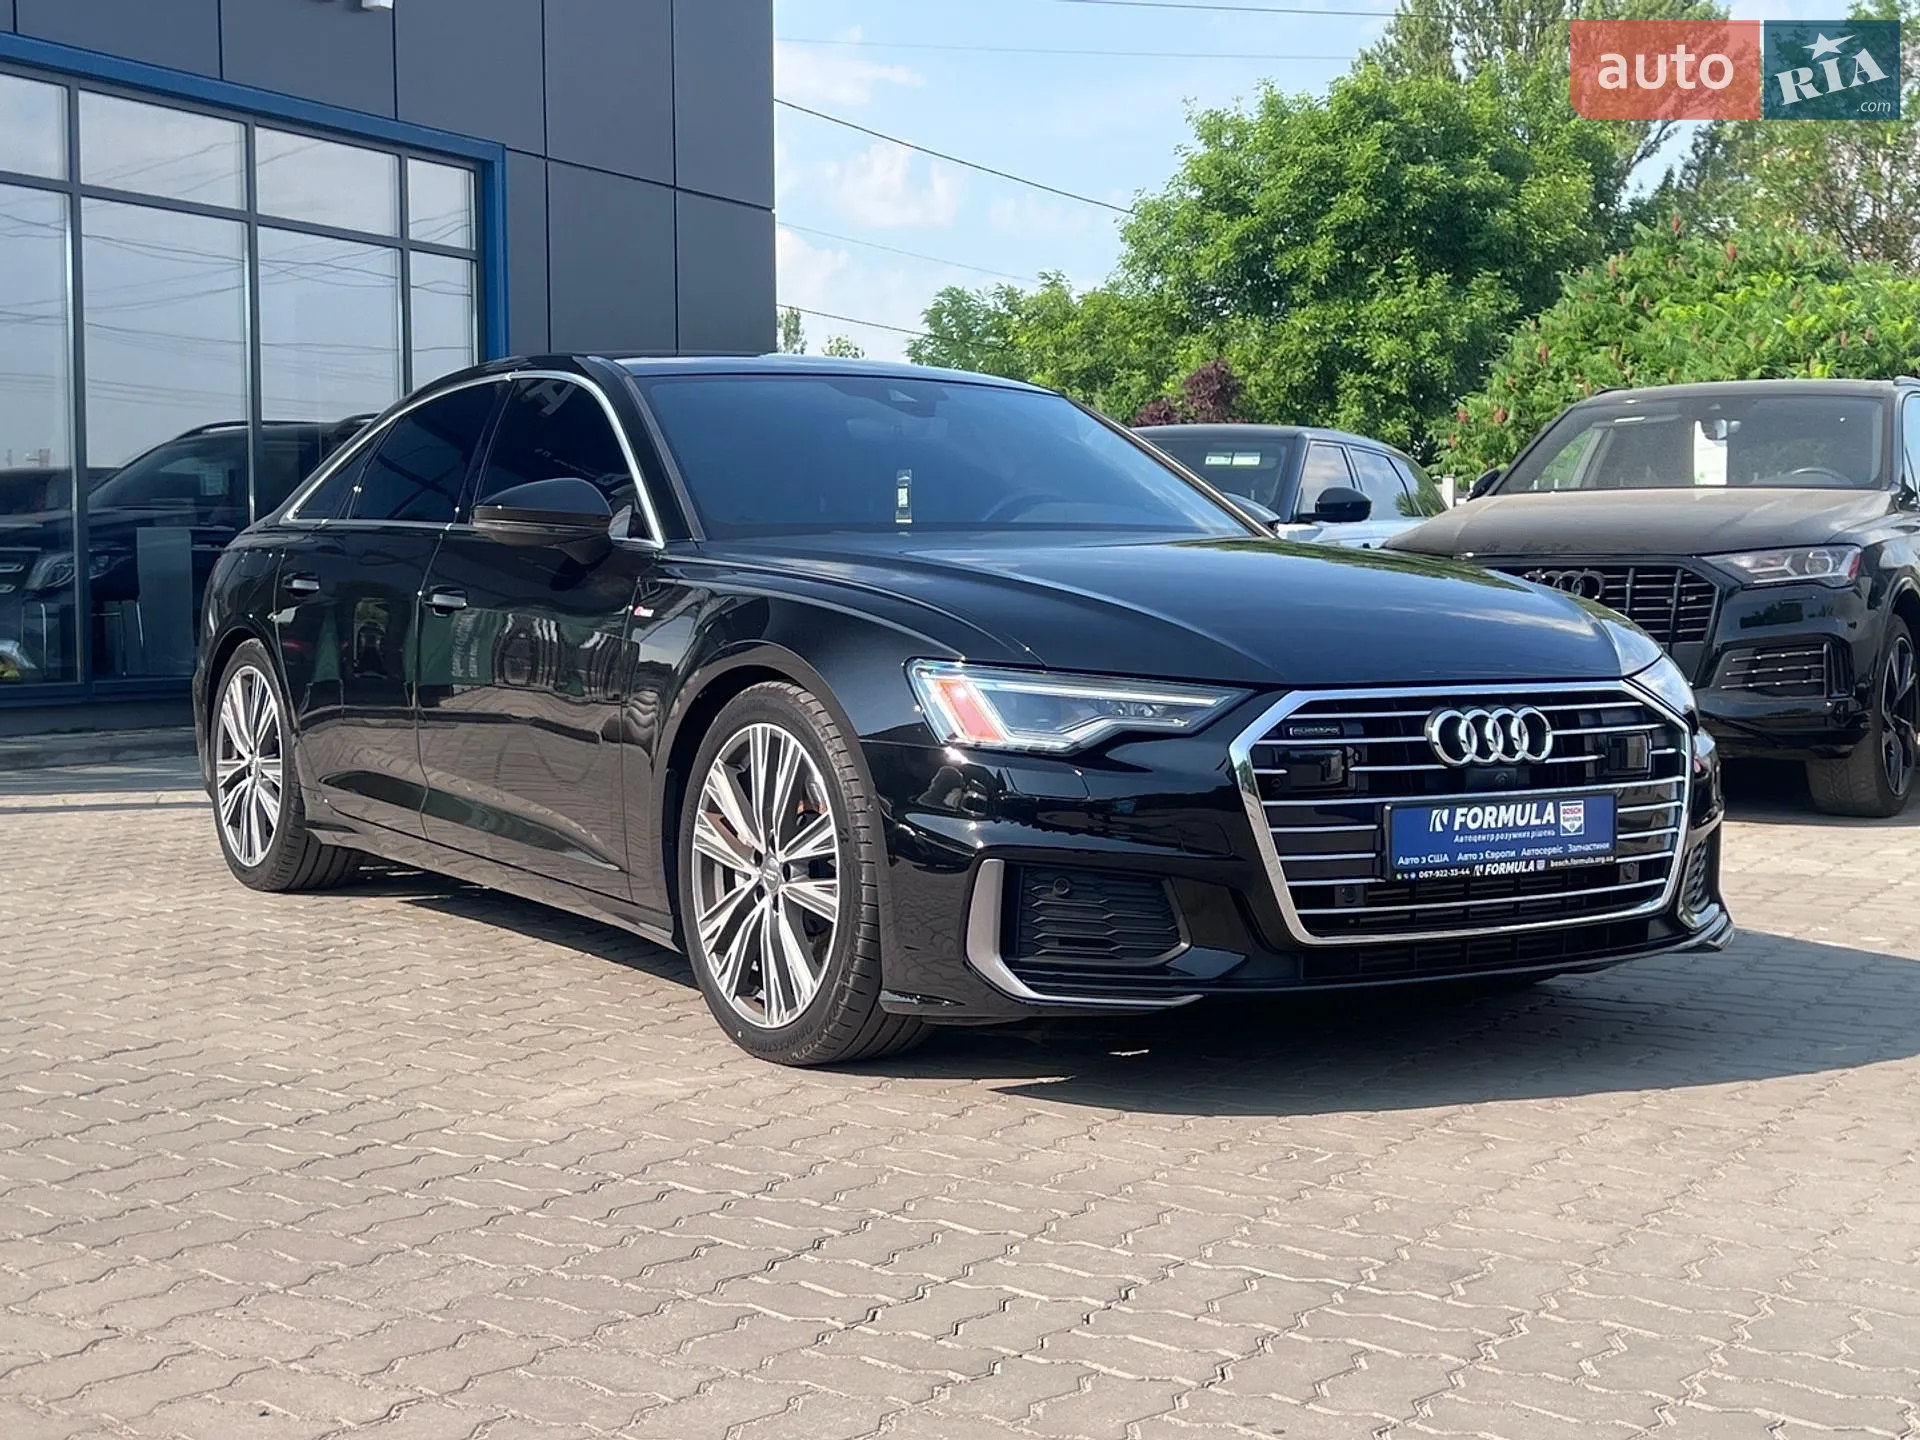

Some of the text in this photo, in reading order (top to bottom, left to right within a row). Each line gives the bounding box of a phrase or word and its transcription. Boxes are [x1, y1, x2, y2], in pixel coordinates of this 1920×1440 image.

[1453, 802, 1556, 831] FORMULA
[1562, 807, 1582, 815] BOSCH
[1457, 852, 1477, 861] Авто
[1485, 850, 1516, 861] Європи
[1521, 845, 1563, 856] Автосервіс
[1397, 856, 1420, 865] Авто
[1427, 853, 1450, 863] США
[1484, 859, 1535, 875] FORMULA
